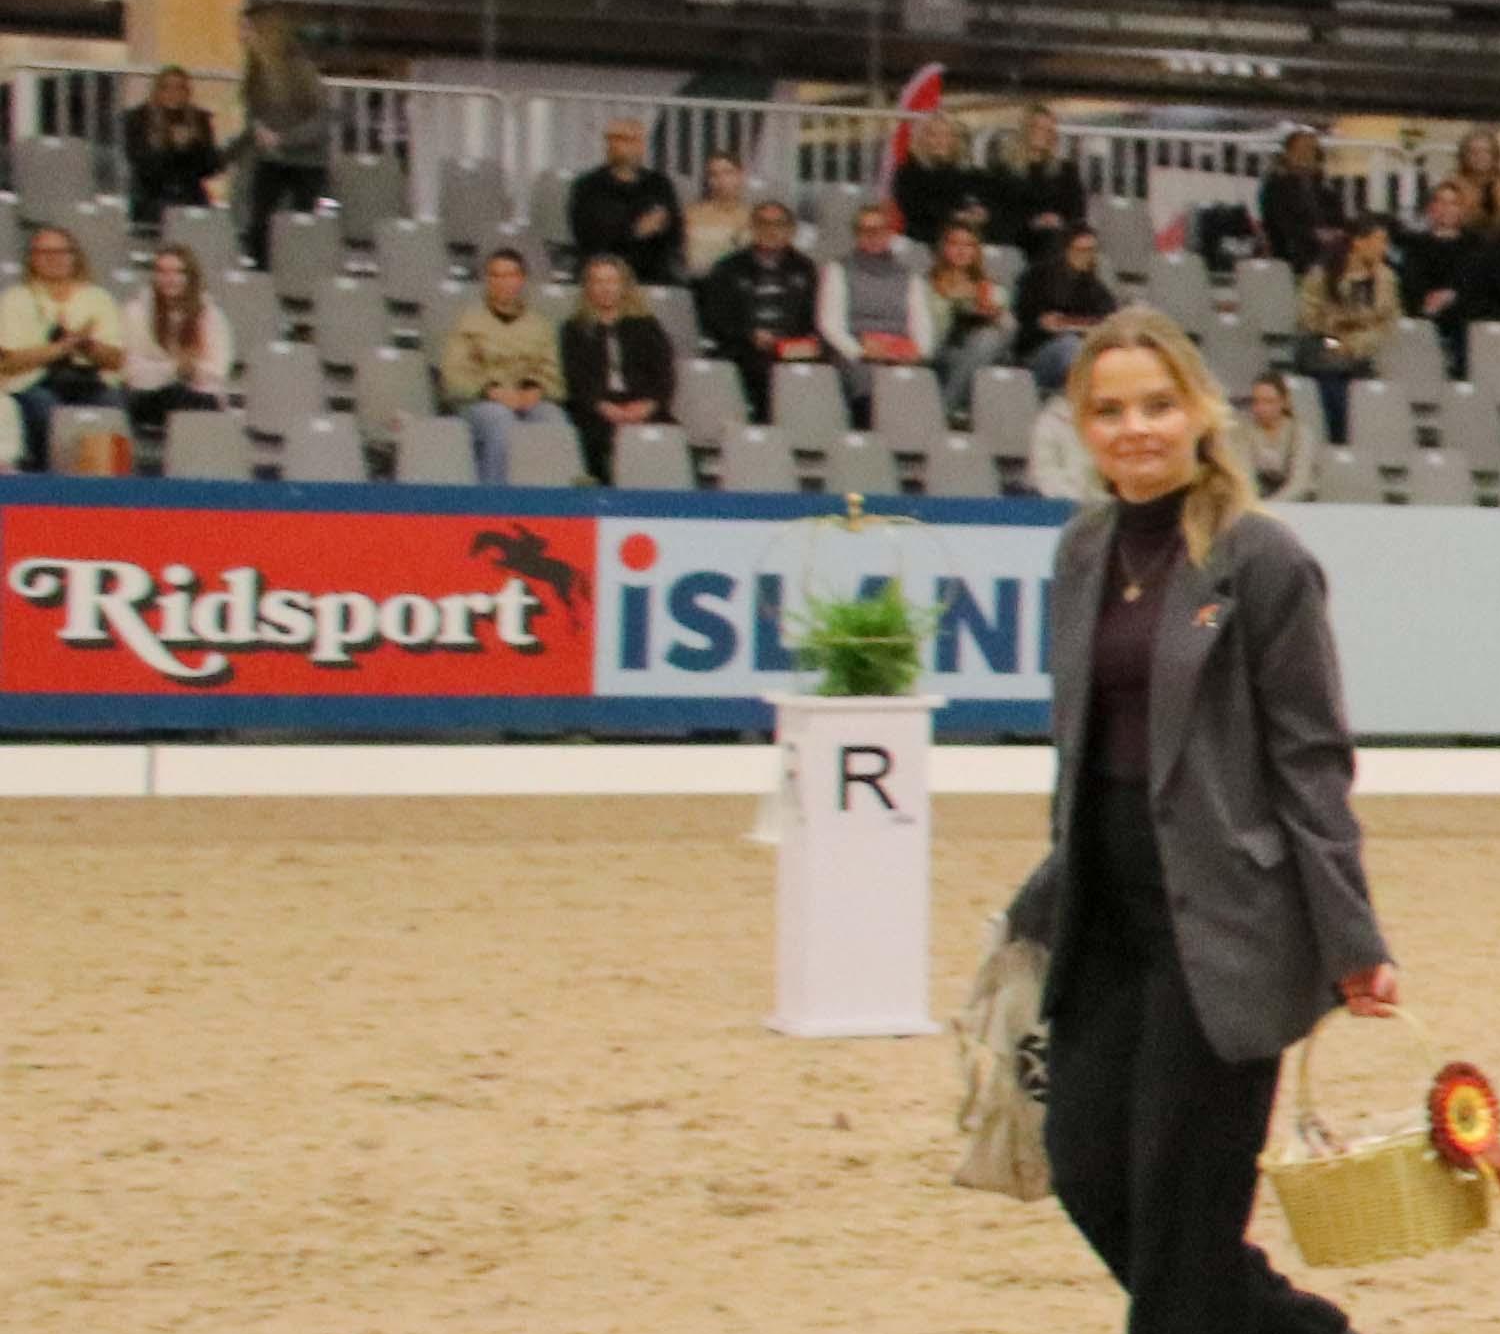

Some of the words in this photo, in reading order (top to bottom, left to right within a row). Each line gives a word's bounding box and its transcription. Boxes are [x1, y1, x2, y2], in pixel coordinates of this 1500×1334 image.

[9, 556, 543, 680] Ridsport
[617, 532, 1056, 673] iSLN
[839, 745, 897, 811] R
